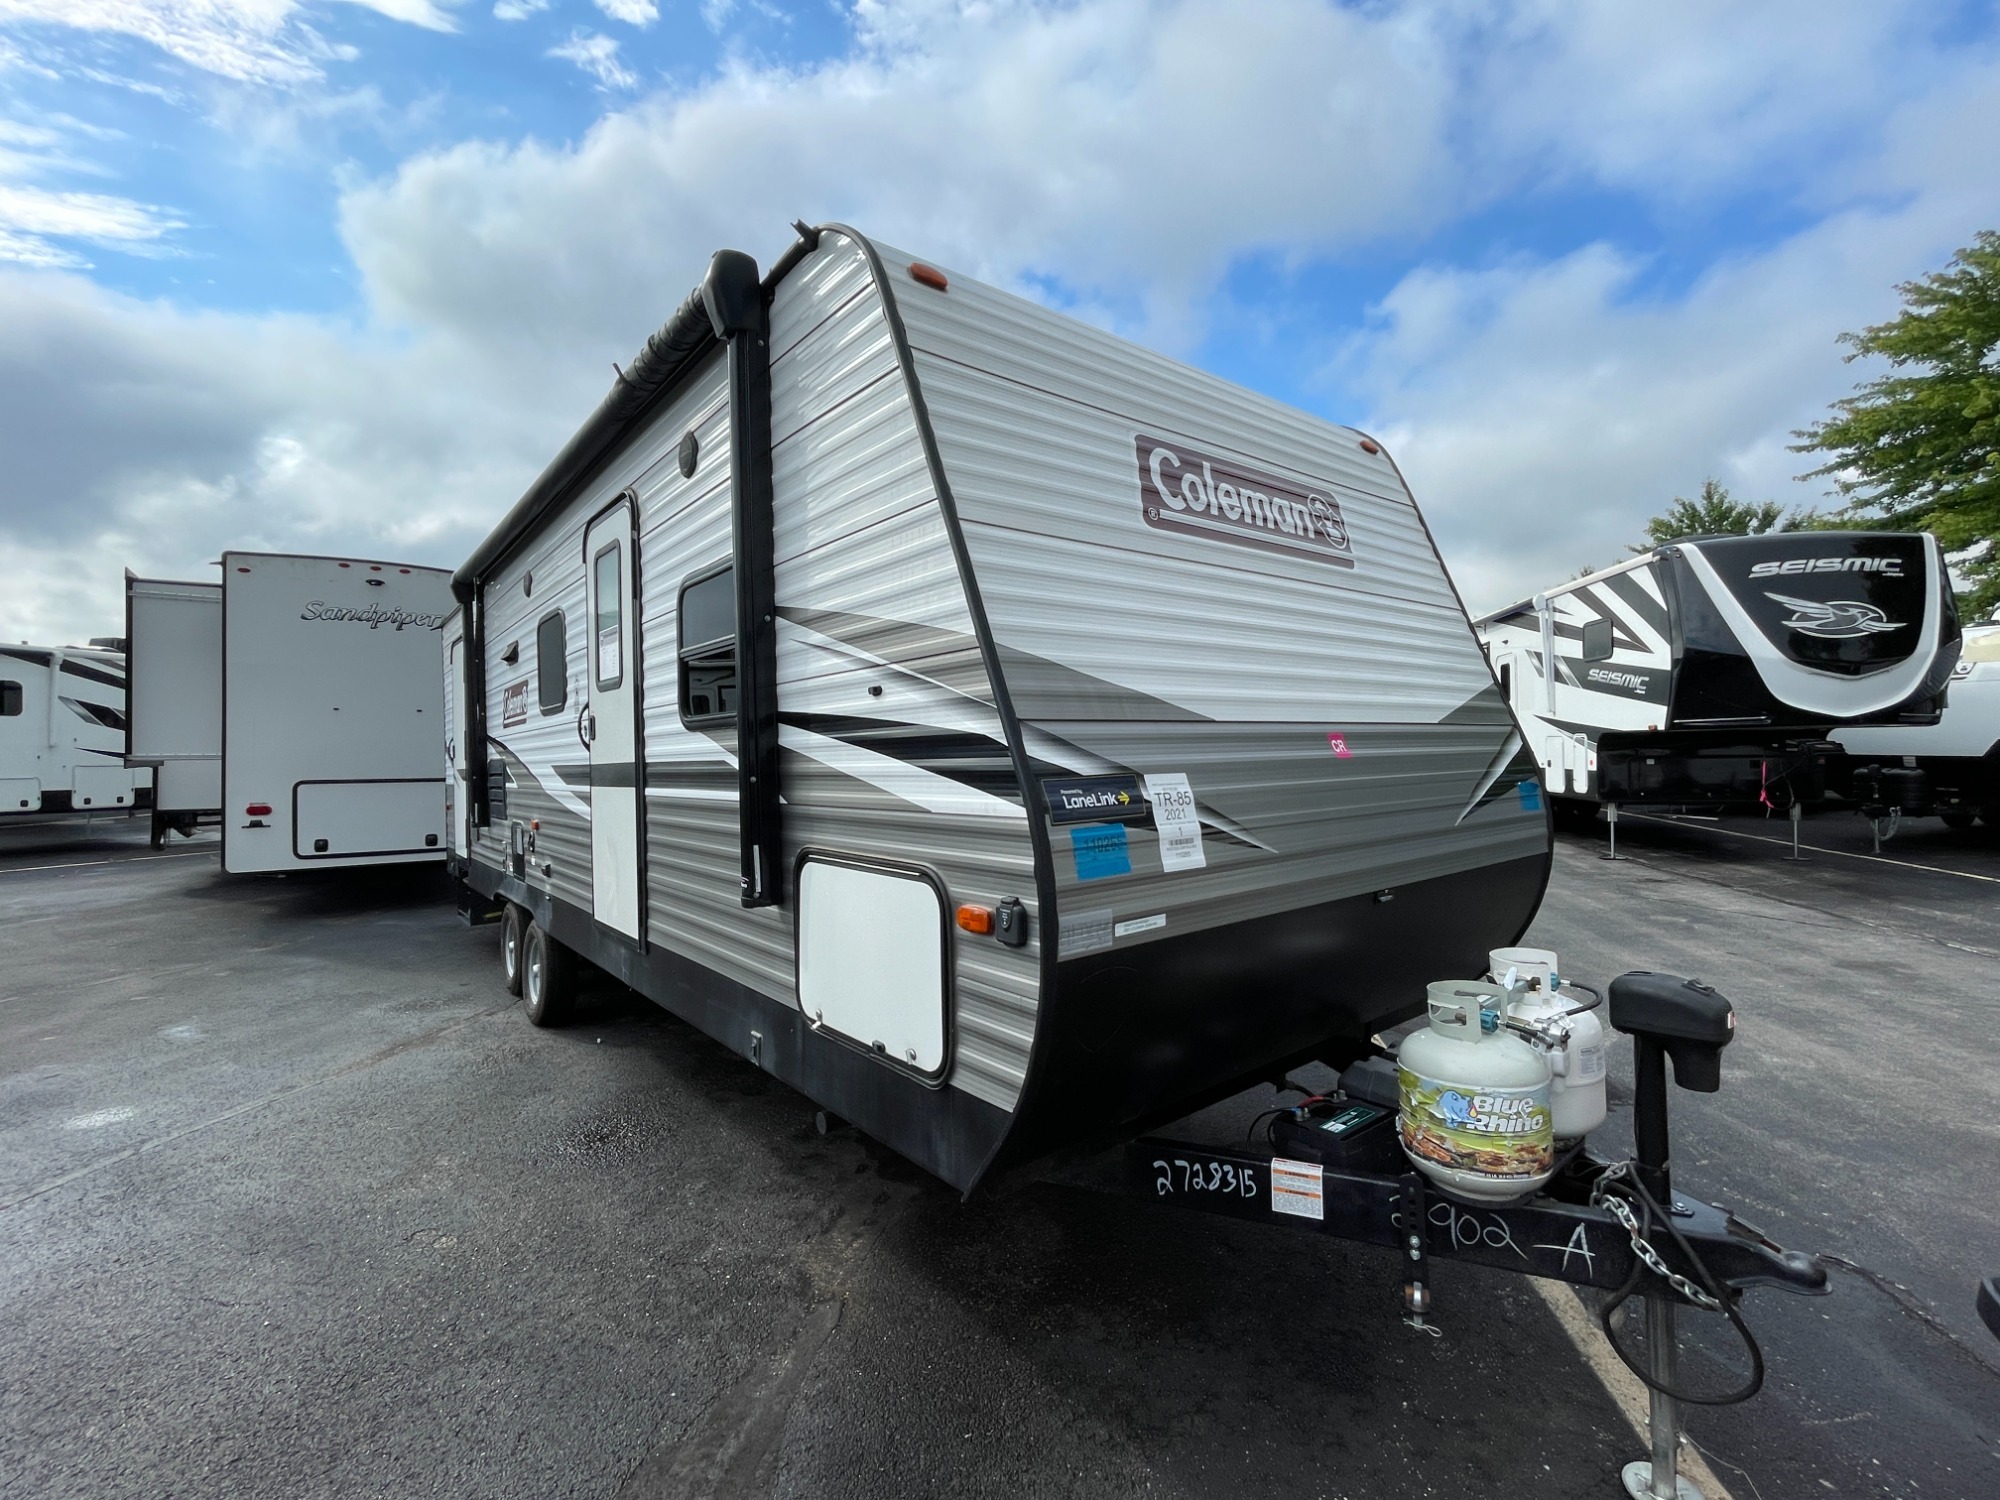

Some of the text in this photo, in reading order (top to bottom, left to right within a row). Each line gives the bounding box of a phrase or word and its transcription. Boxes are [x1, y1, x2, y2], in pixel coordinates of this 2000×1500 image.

[1149, 447, 1316, 539] Coleman
[1748, 557, 1903, 579] SEISMIC
[301, 600, 443, 631] Sandpiper
[1587, 668, 1650, 690] SEISMIC
[1331, 739, 1347, 753] CR
[1062, 791, 1118, 809] LaneLink
[1153, 791, 1192, 807] TR-85
[1164, 808, 1187, 821] 2021
[1178, 826, 1183, 837] 1
[1472, 1095, 1535, 1115] Blue
[1466, 1114, 1544, 1133] Rhino
[1153, 1160, 1258, 1198] 2728315
